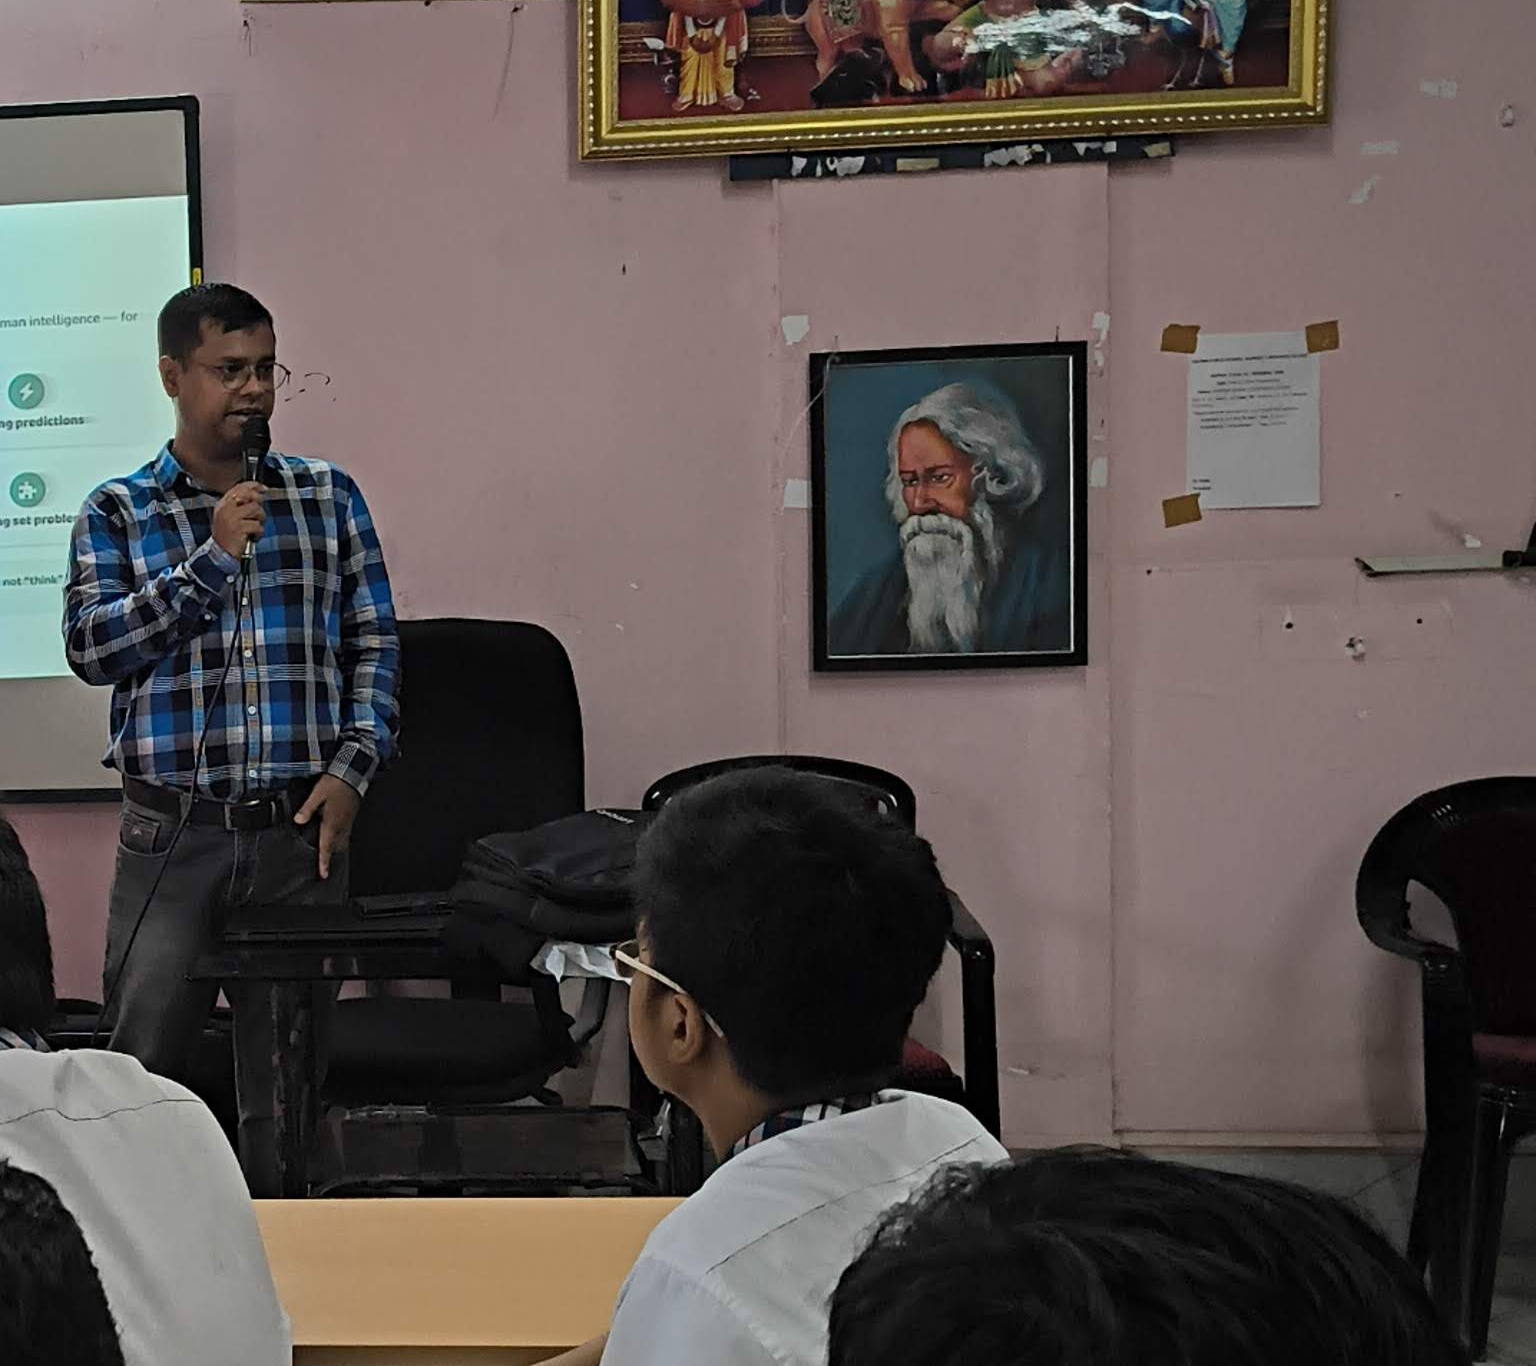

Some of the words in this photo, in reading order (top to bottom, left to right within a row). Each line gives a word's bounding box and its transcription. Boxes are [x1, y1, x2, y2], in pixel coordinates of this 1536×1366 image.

[29, 312, 101, 328] intelligence
[121, 310, 138, 322] for
[15, 414, 85, 430] predictions
[12, 515, 32, 525] set
[2, 577, 22, 586] not
